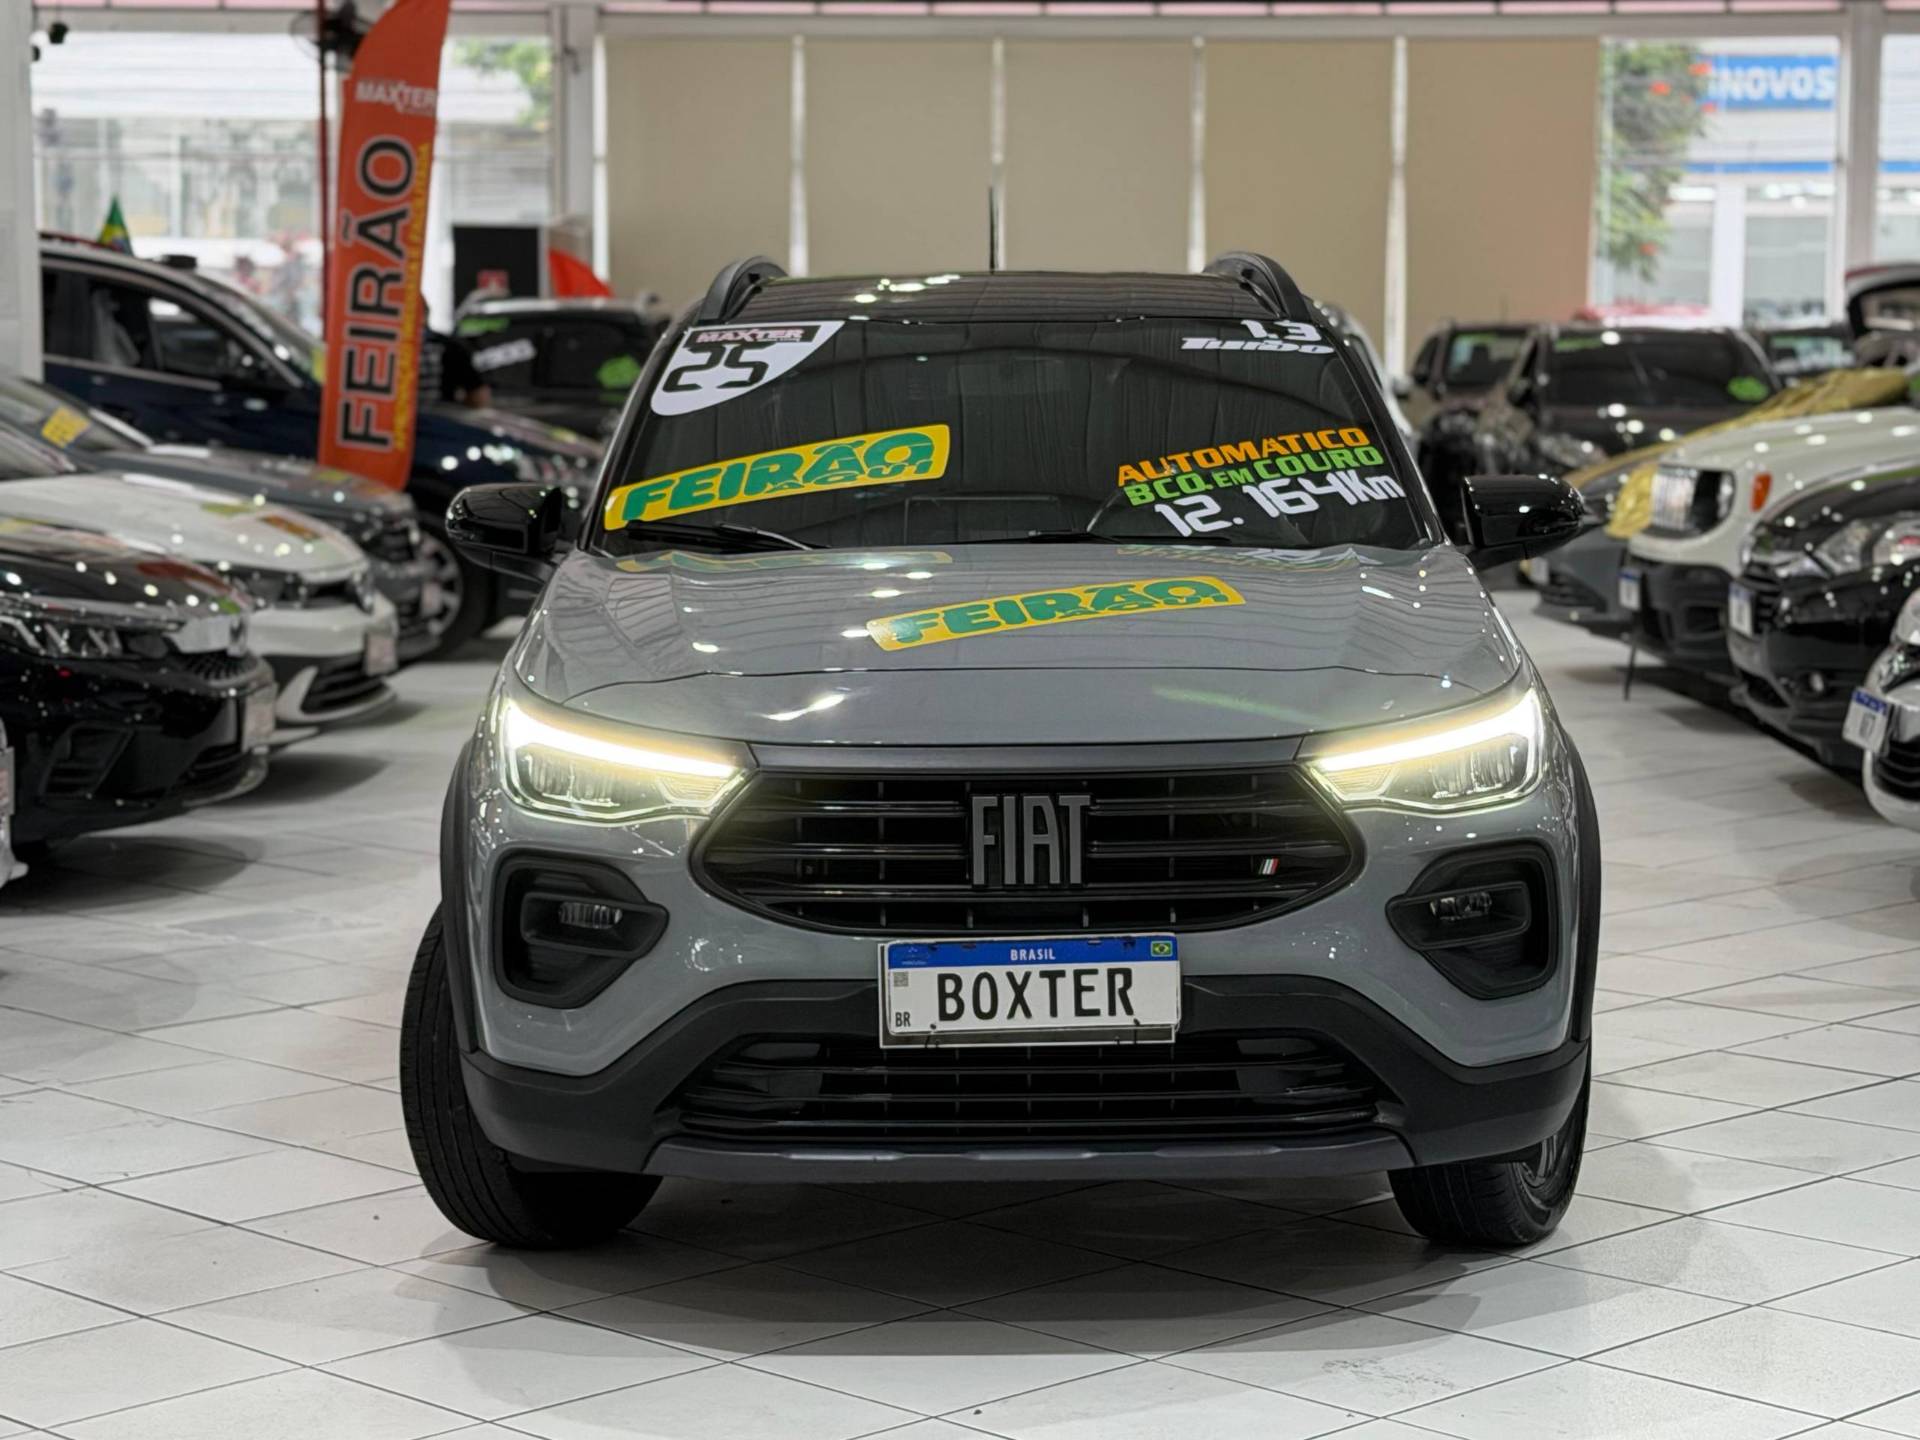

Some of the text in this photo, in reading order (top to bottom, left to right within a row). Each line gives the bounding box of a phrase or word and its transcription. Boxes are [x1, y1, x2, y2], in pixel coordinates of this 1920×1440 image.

[356, 80, 438, 113] MAXTER
[337, 133, 417, 452] FEIRÃO
[696, 328, 804, 343] MAXTER
[662, 343, 770, 393] 25
[621, 432, 936, 521] FEIRÃO
[1211, 467, 1254, 489] EM
[1252, 445, 1385, 480] COURO
[890, 579, 1224, 643] FEIRÃO
[972, 795, 1091, 885] FIAT
[1010, 948, 1057, 962] BRASIL
[895, 1011, 911, 1028] BR
[937, 967, 1135, 1022] BOXTER
